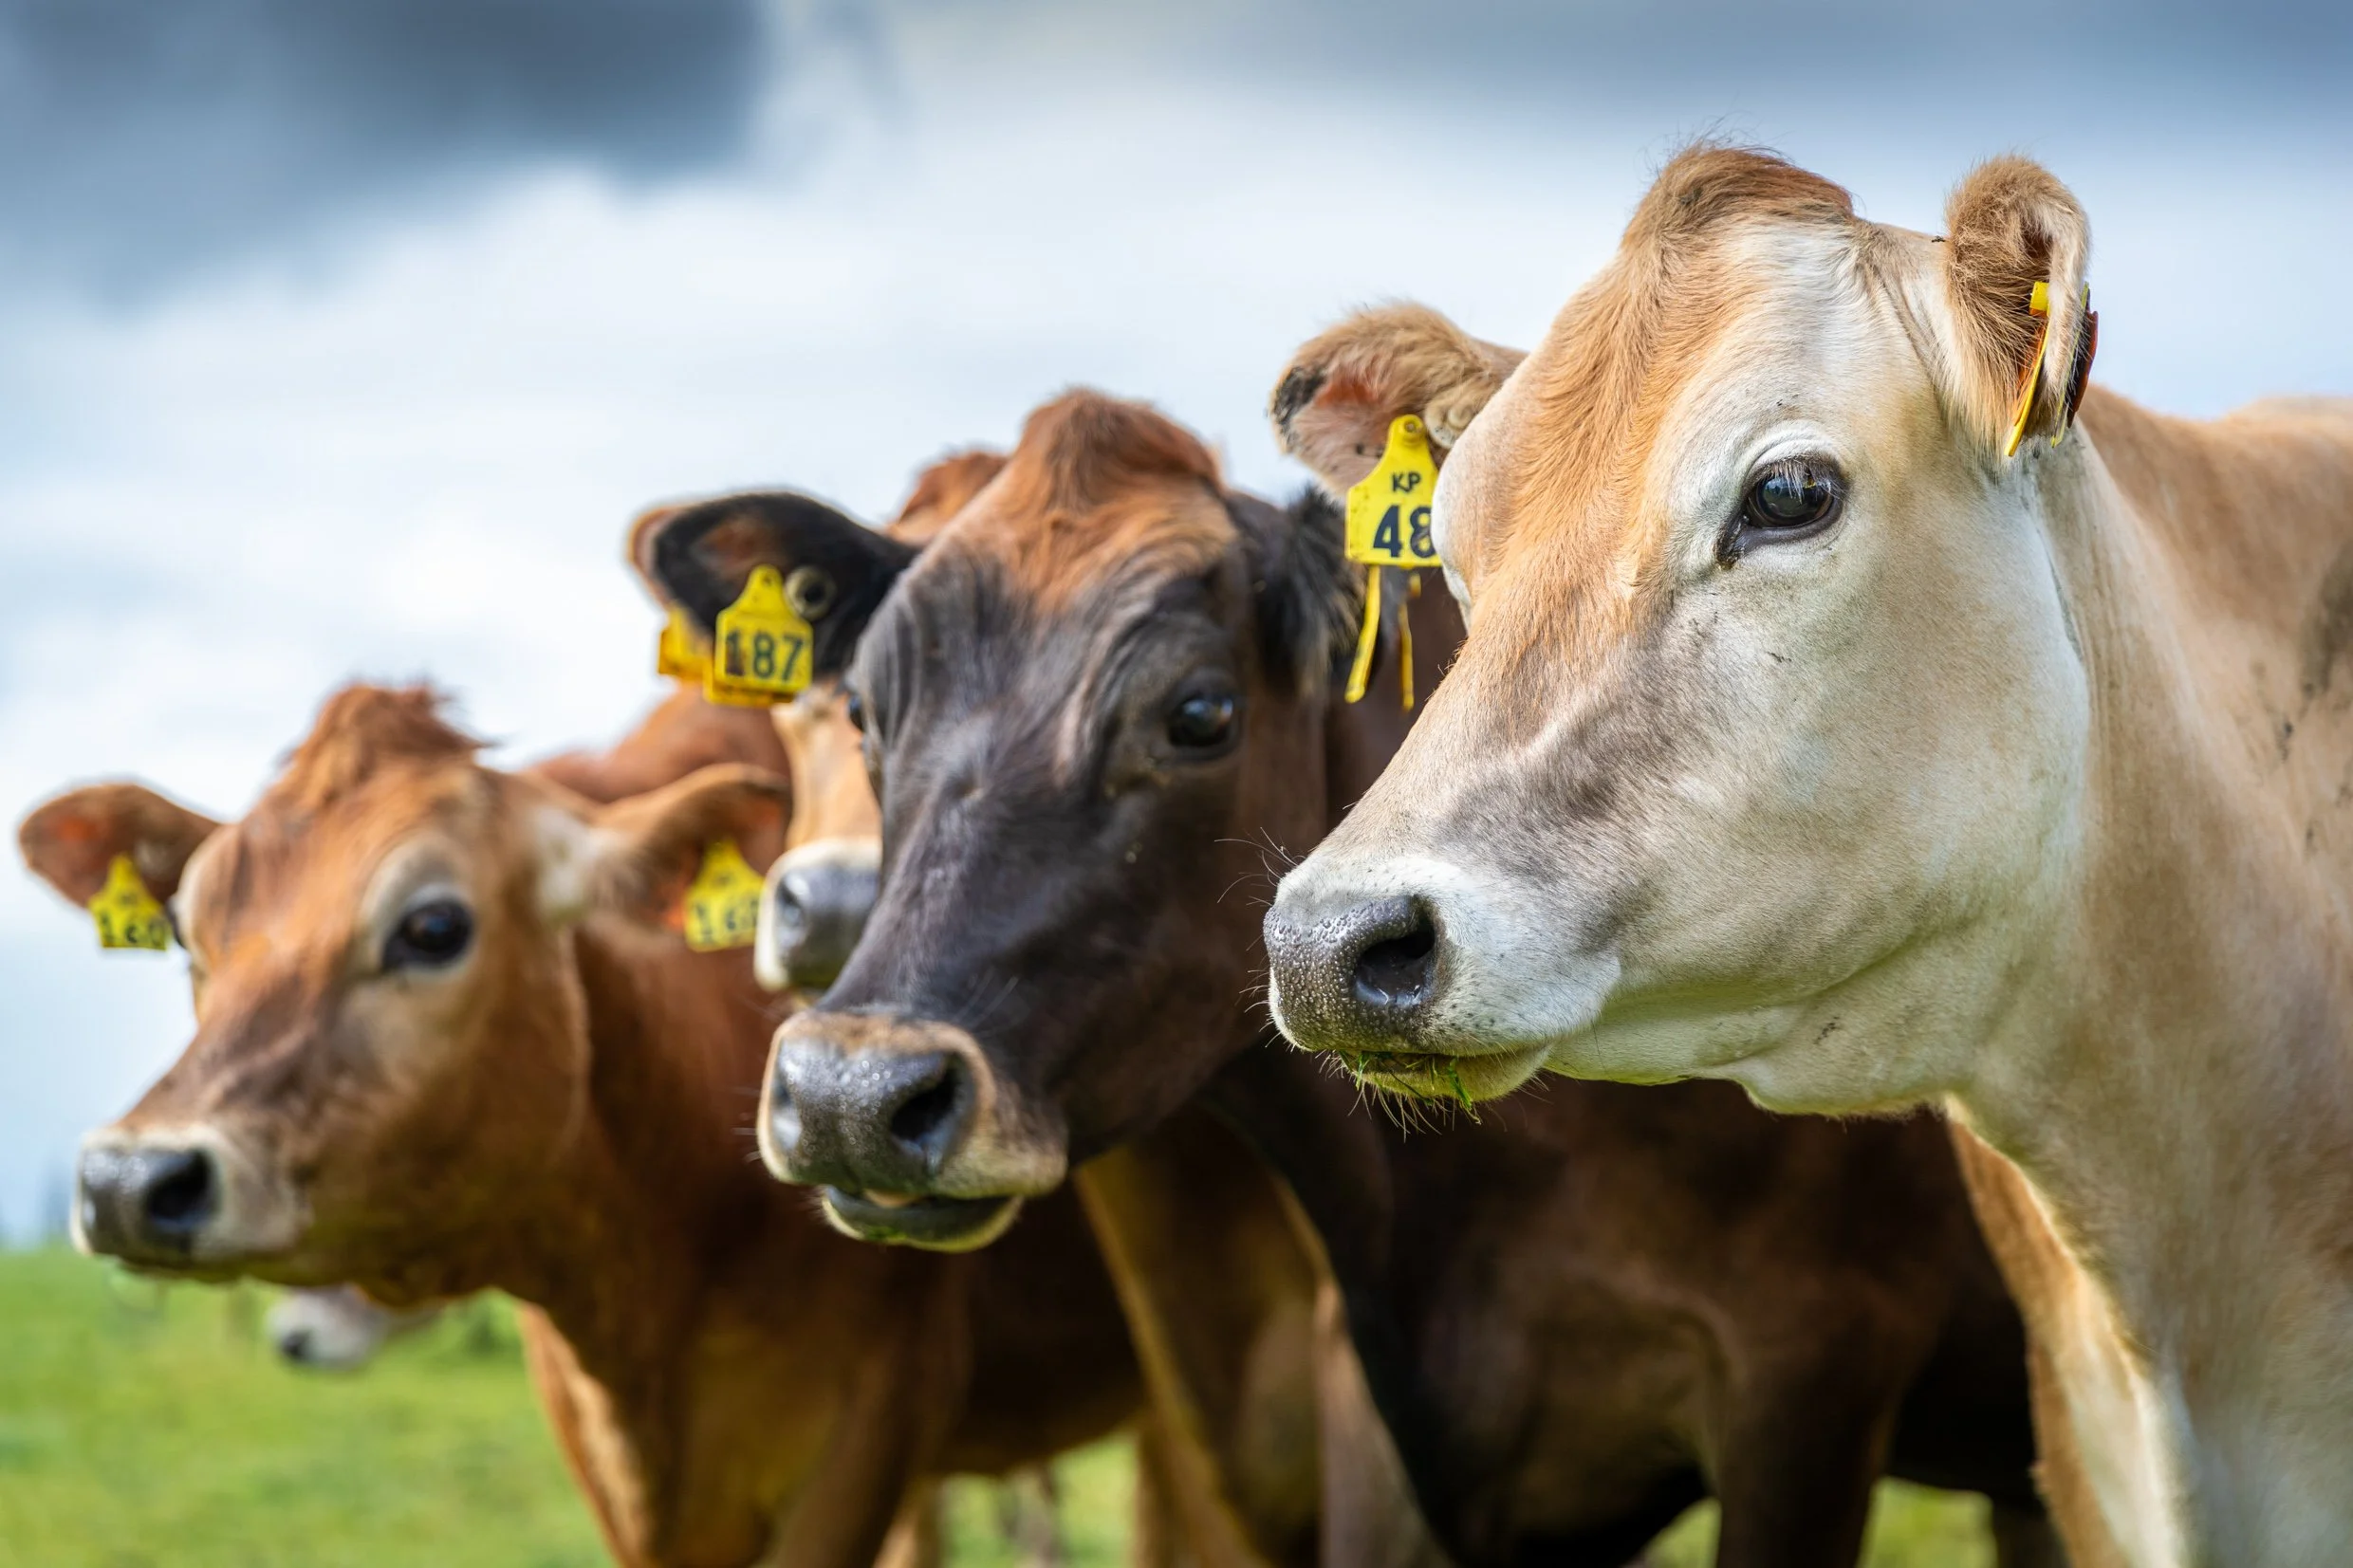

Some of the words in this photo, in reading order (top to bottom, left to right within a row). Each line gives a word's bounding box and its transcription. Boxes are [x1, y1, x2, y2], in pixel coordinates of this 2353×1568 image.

[1391, 471, 1421, 493] KP
[1372, 504, 1436, 559] 48
[725, 627, 804, 682] 187
